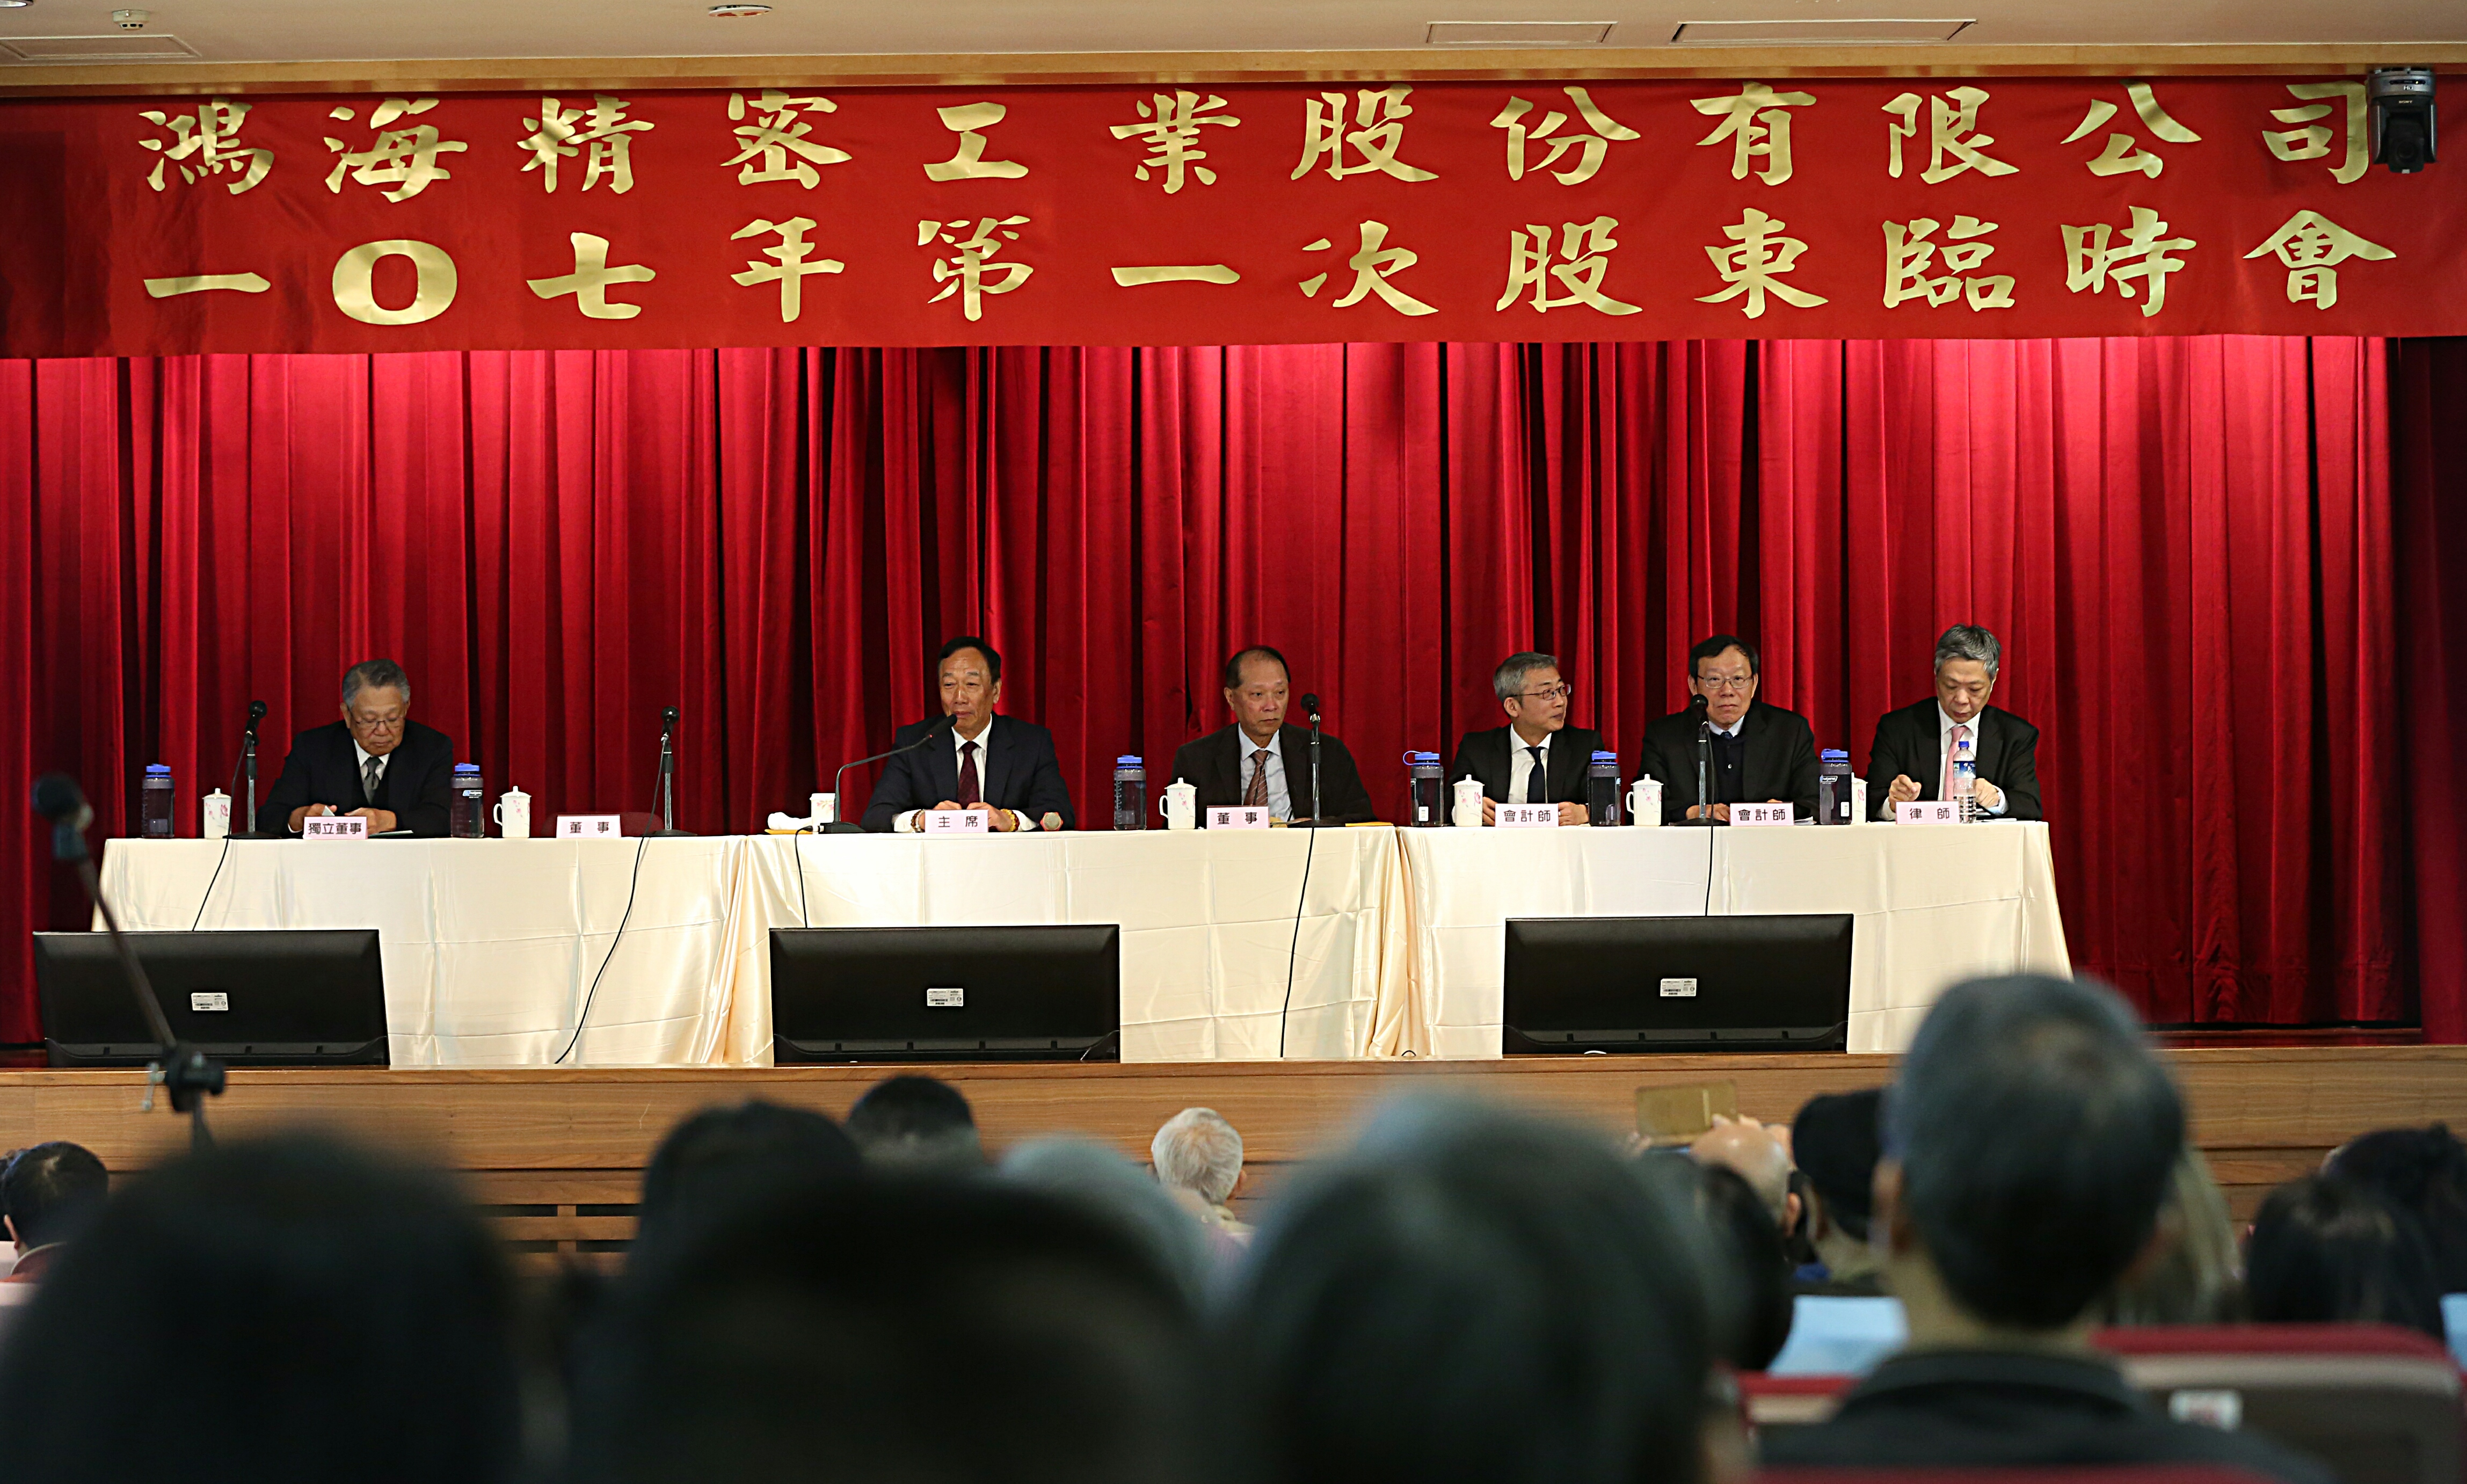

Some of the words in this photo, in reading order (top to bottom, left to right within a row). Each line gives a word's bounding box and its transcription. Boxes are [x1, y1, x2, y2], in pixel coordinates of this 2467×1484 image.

[138, 79, 2370, 203] 鴻海精密工業股份有限公司
[1503, 810, 1551, 822] 會計師
[1738, 809, 1786, 821] 會計師
[1909, 808, 1950, 819] 律師
[938, 816, 978, 827] 主席
[308, 823, 362, 834] 獨立董事
